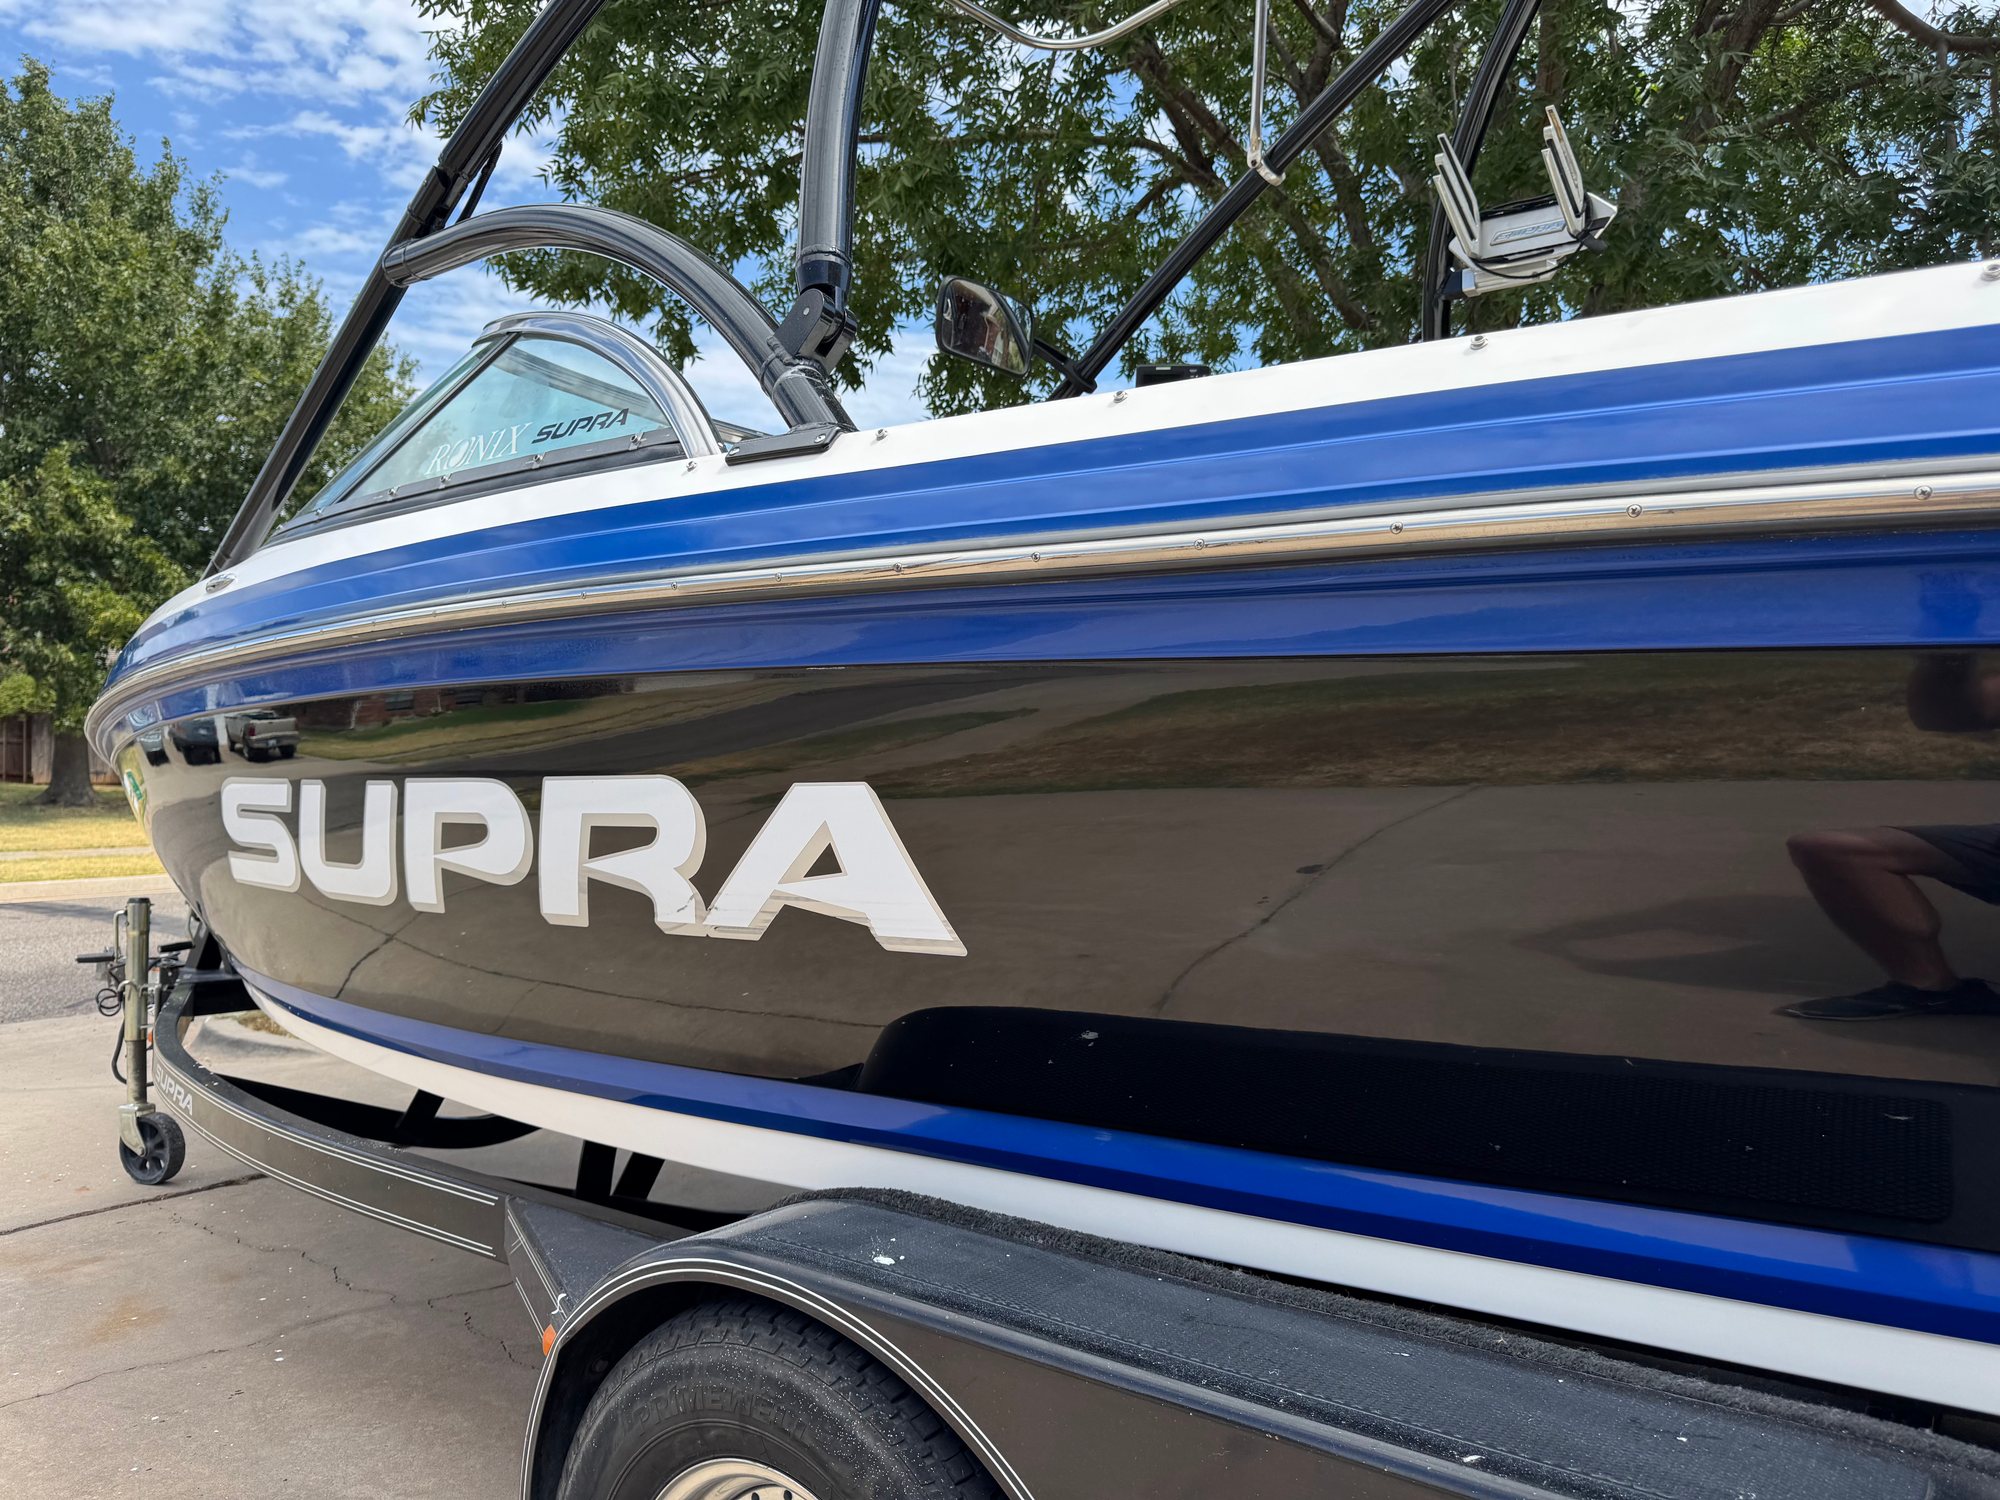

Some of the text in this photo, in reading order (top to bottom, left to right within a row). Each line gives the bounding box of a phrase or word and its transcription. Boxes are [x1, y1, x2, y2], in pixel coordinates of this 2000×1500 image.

[424, 422, 533, 476] RONIX
[532, 408, 629, 444] SUPRA
[220, 774, 968, 957] SUPRA
[155, 1063, 193, 1116] SUPRA
